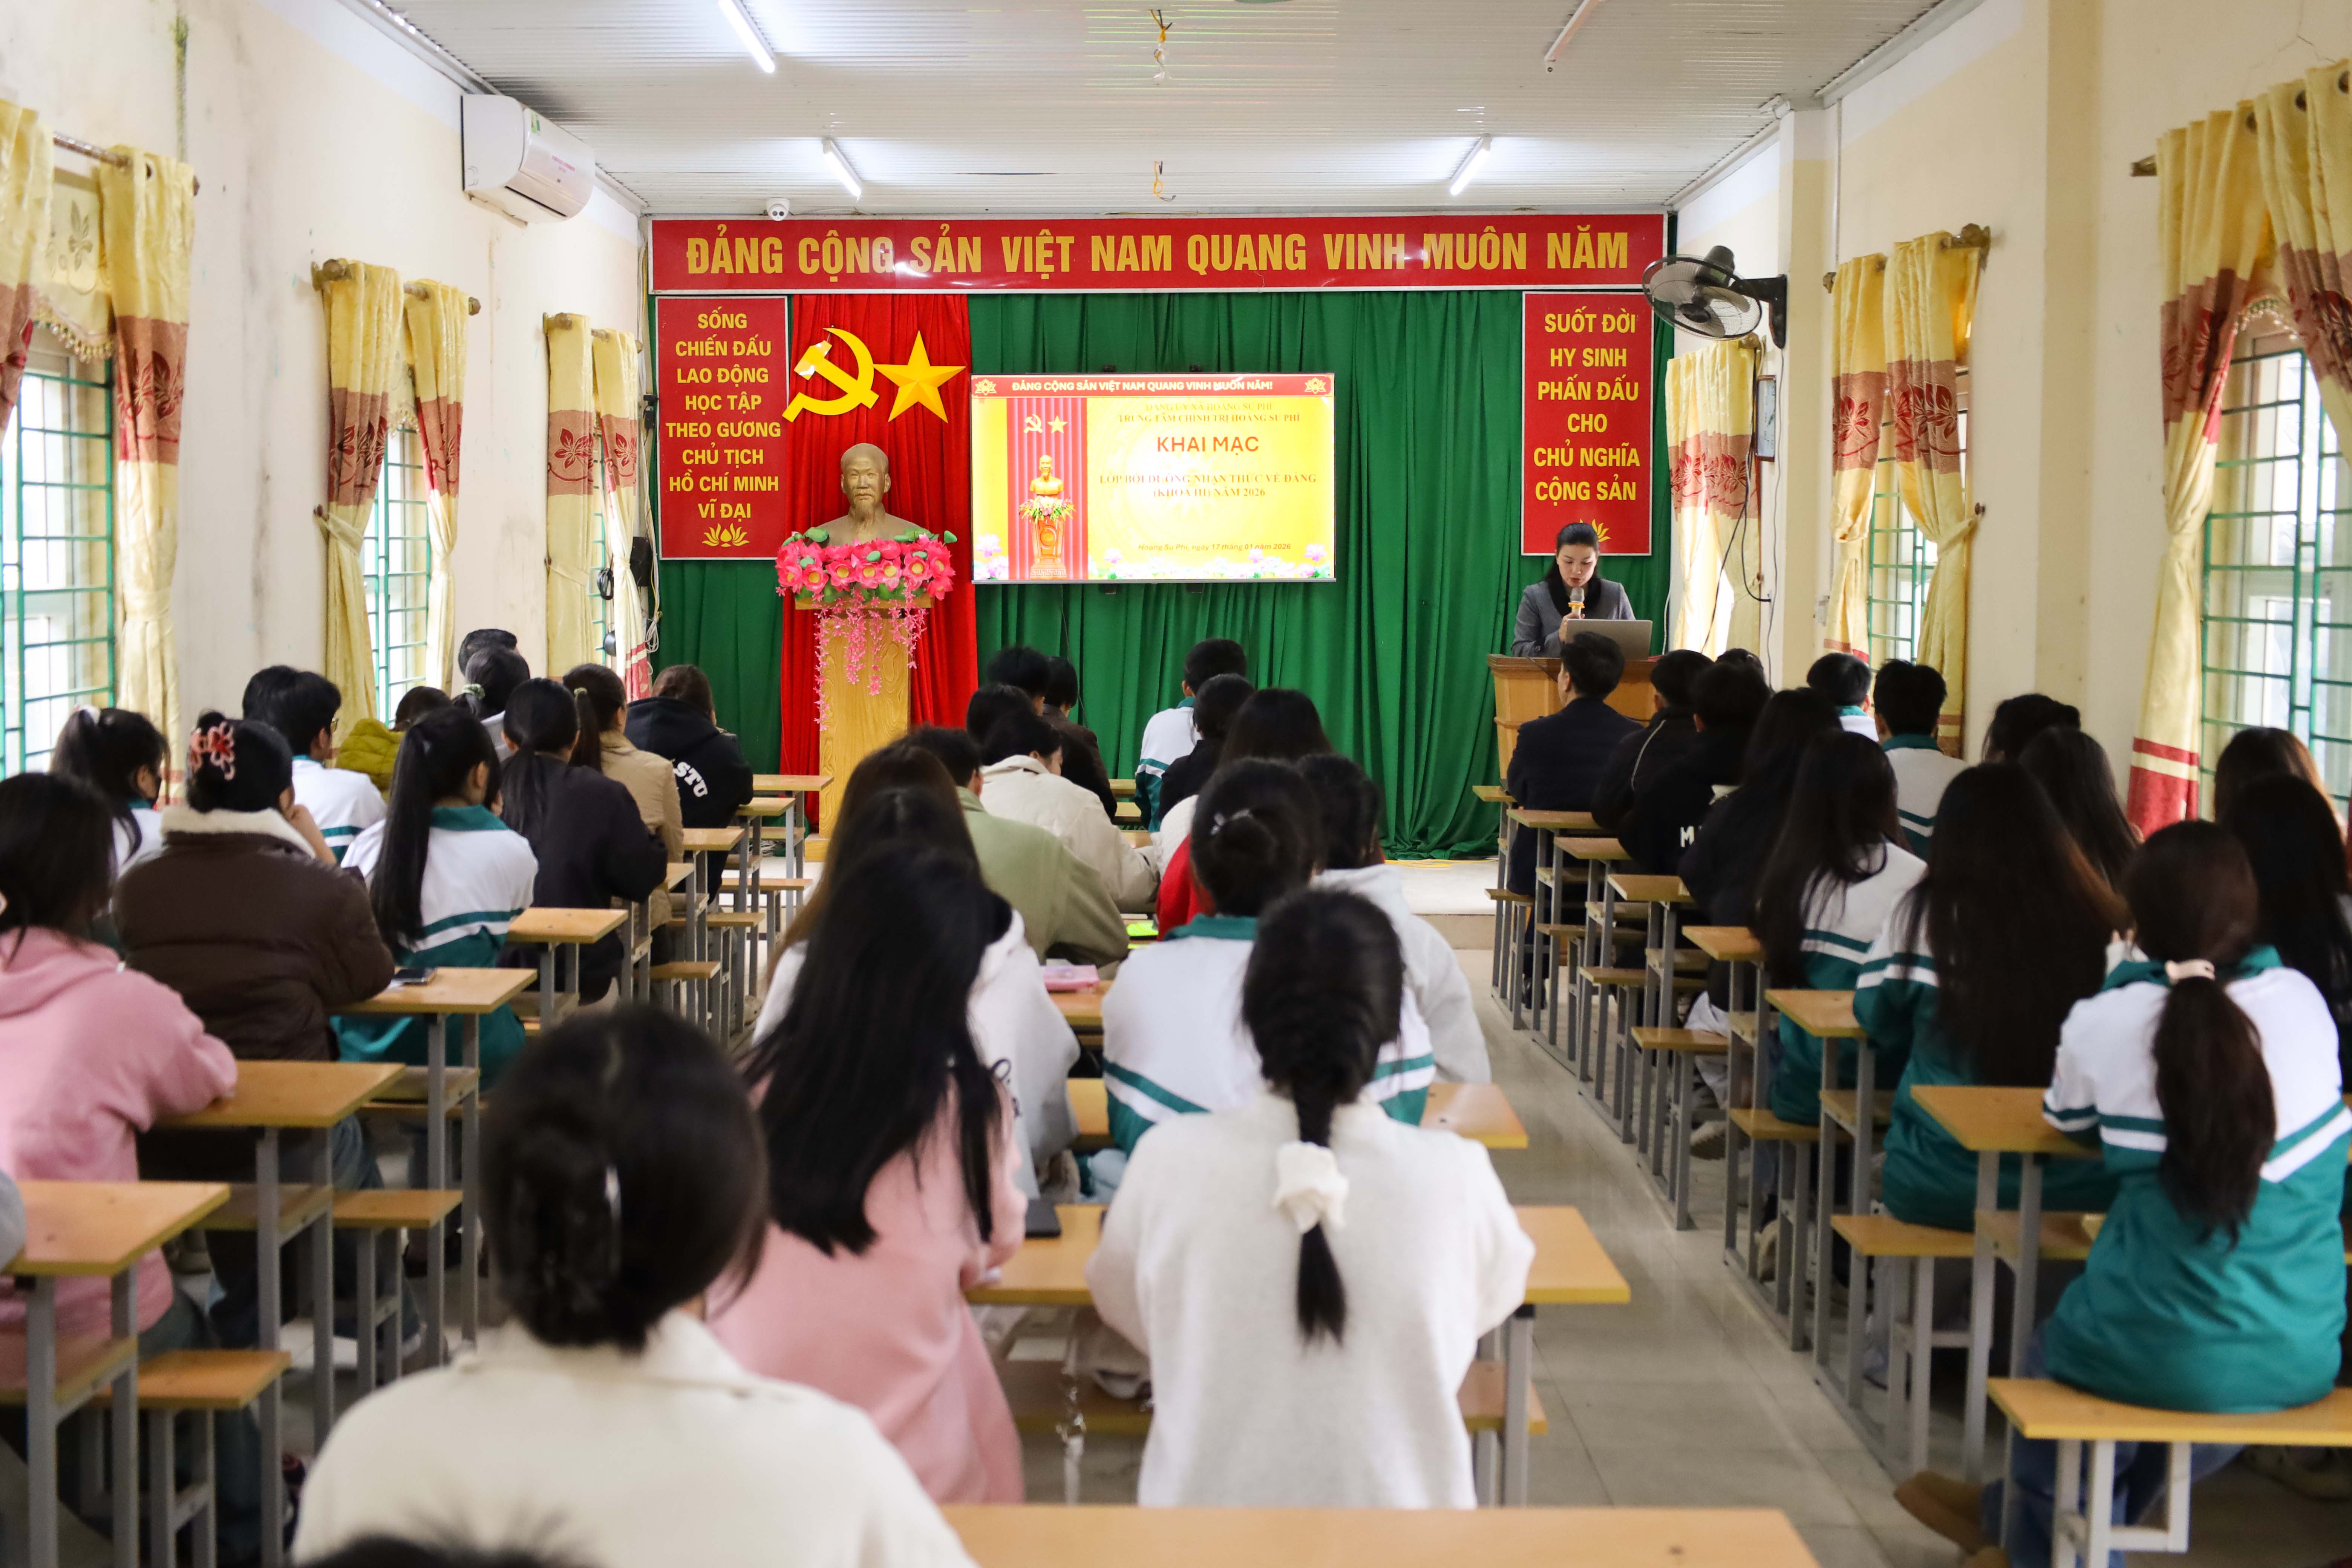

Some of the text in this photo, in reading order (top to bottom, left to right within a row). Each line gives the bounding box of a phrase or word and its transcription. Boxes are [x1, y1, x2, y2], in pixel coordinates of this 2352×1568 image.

[687, 224, 1628, 282] ĐẢNG CỘNG SẢN VIỆT NAM QUANG VINH MUÔN NĂM
[698, 306, 747, 329] SỐNG
[1545, 306, 1635, 333] SUỐT ĐỜI
[676, 334, 771, 357] CHIẾN ĐẤU
[1550, 348, 1627, 367] HY SINH
[677, 364, 769, 387] LAO ĐỘNG
[1012, 380, 1041, 390] ĐẢNG
[1044, 380, 1074, 392] CỘNG
[1076, 380, 1097, 390] SẢN
[1099, 380, 1121, 392] VIỆT
[1122, 382, 1145, 390] NAM
[1147, 381, 1184, 392] QUANG
[1186, 381, 1211, 390] VINH
[1247, 380, 1272, 390] NĂM!
[1538, 374, 1638, 401] PHẤN ĐẤU
[686, 391, 762, 415] HỌC TẬP
[666, 421, 781, 438] THEO GƯƠNG
[1568, 413, 1608, 433] CHO
[682, 442, 764, 469] CHỦ TỊCH
[1158, 436, 1259, 456] KHAI MẠC
[1534, 439, 1640, 467] CHỦ NGHĨA
[670, 469, 779, 492] HỒ CHÍ MINH
[1243, 488, 1266, 496] 2026
[1536, 474, 1636, 506] CỘNG SẢN
[698, 498, 751, 522] VĨ ĐẠI
[672, 759, 708, 798] STU
